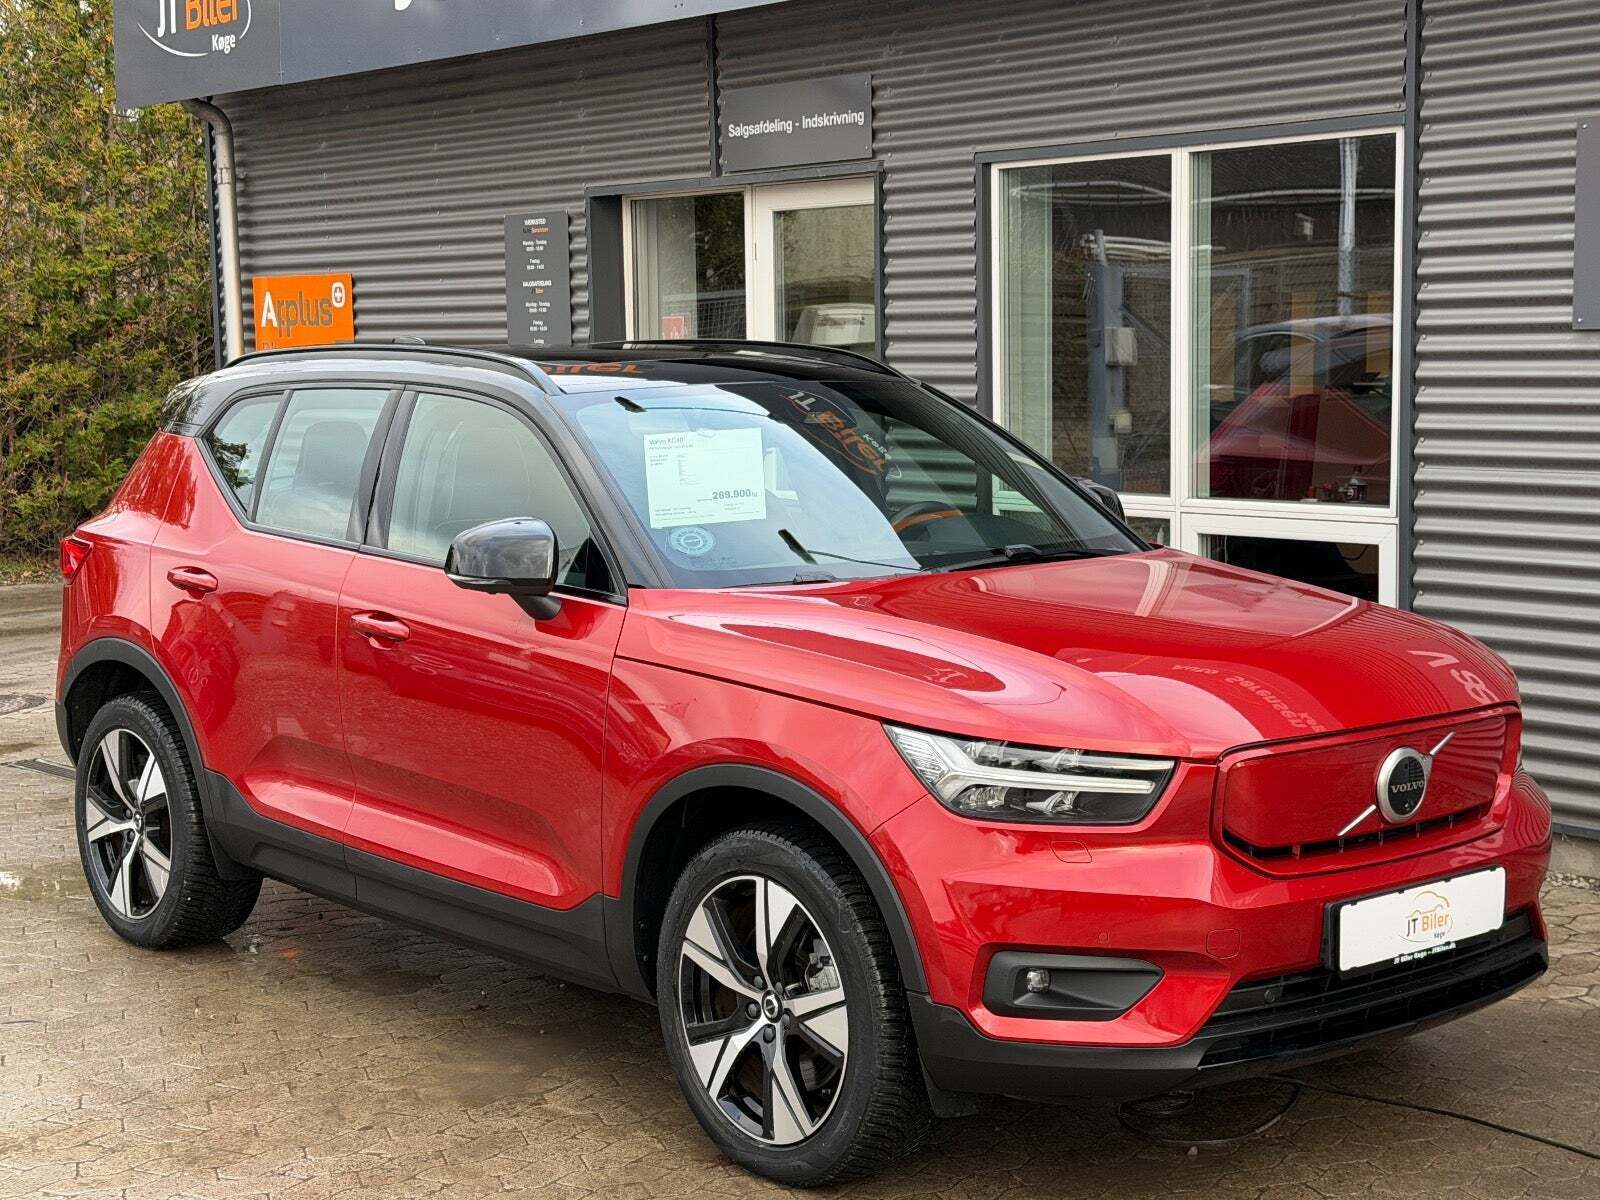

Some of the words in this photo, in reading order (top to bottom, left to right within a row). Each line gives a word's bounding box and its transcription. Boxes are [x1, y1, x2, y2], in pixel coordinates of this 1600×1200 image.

[211, 33, 236, 54] Køge
[728, 120, 793, 139] Salgsafdeling
[802, 110, 865, 129] Indskrivning
[1391, 780, 1425, 793] VOLVO
[1407, 918, 1418, 937] JT
[1422, 912, 1449, 932] Biler
